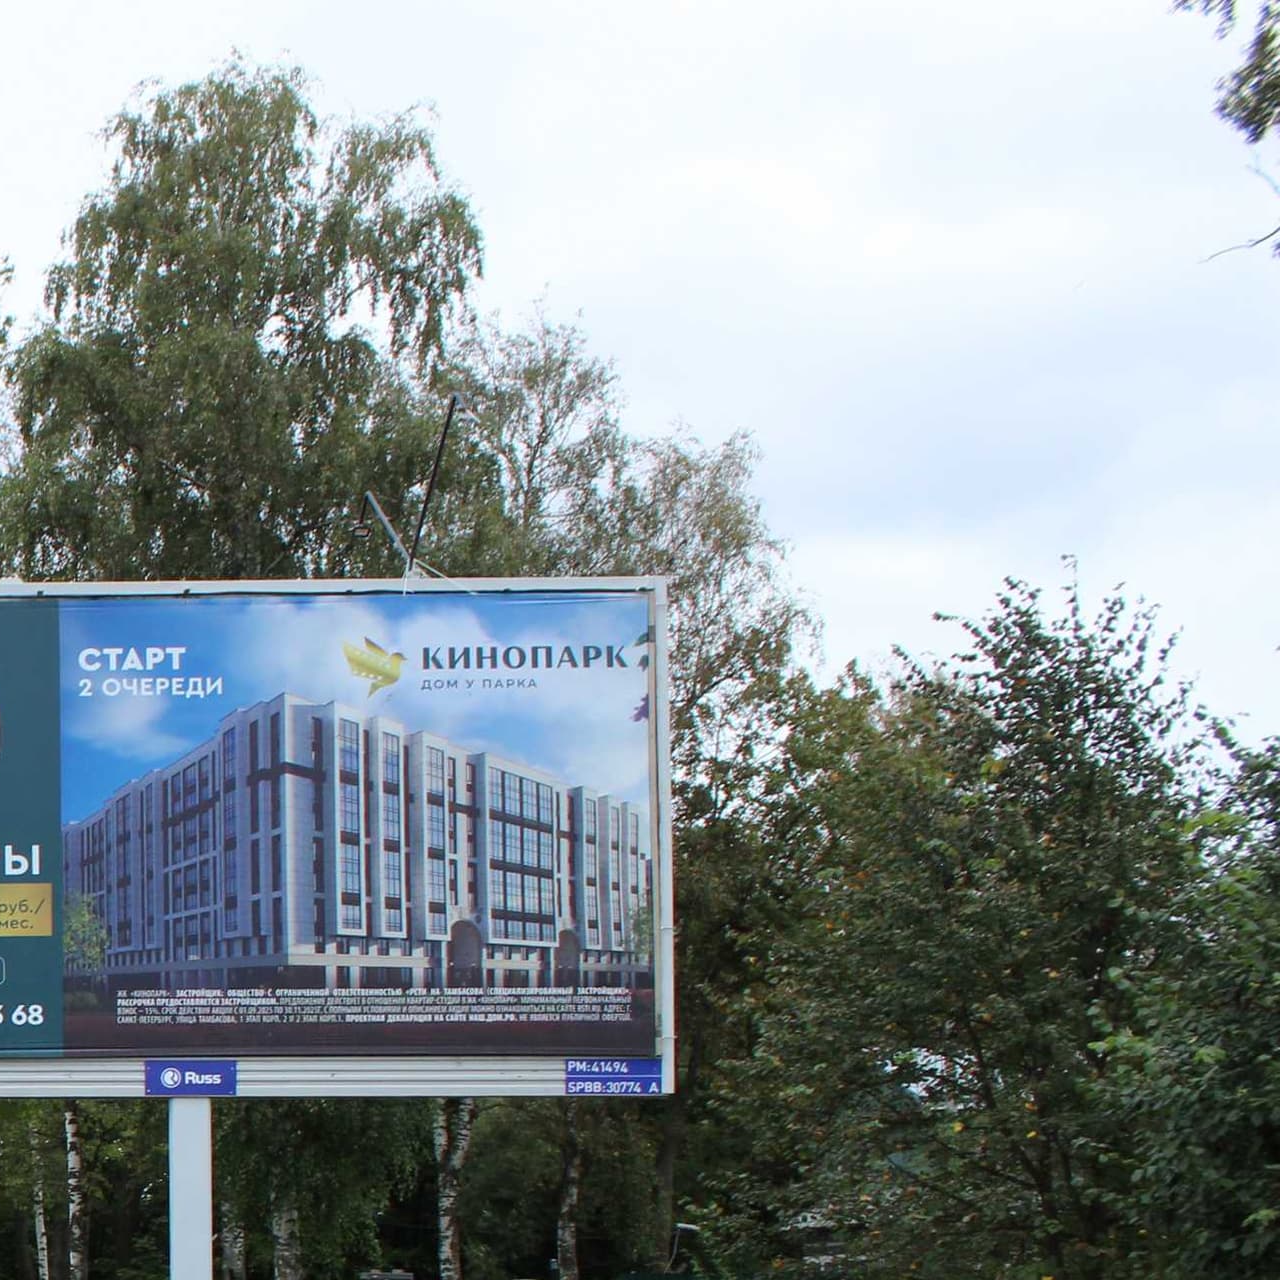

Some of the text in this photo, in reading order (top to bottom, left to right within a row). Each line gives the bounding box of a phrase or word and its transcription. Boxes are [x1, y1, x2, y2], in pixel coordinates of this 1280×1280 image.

[78, 647, 186, 671] СТАРТ
[422, 646, 628, 670] КИНОПАРК
[78, 677, 223, 699] 2 ОЧЕРЕДИ
[421, 678, 537, 691] ДОМ У ПАРКА
[11, 1004, 44, 1025] 68
[567, 1061, 628, 1073] PM:41494
[185, 1071, 222, 1084] Russ
[567, 1082, 659, 1093] SPBB:30774 A
